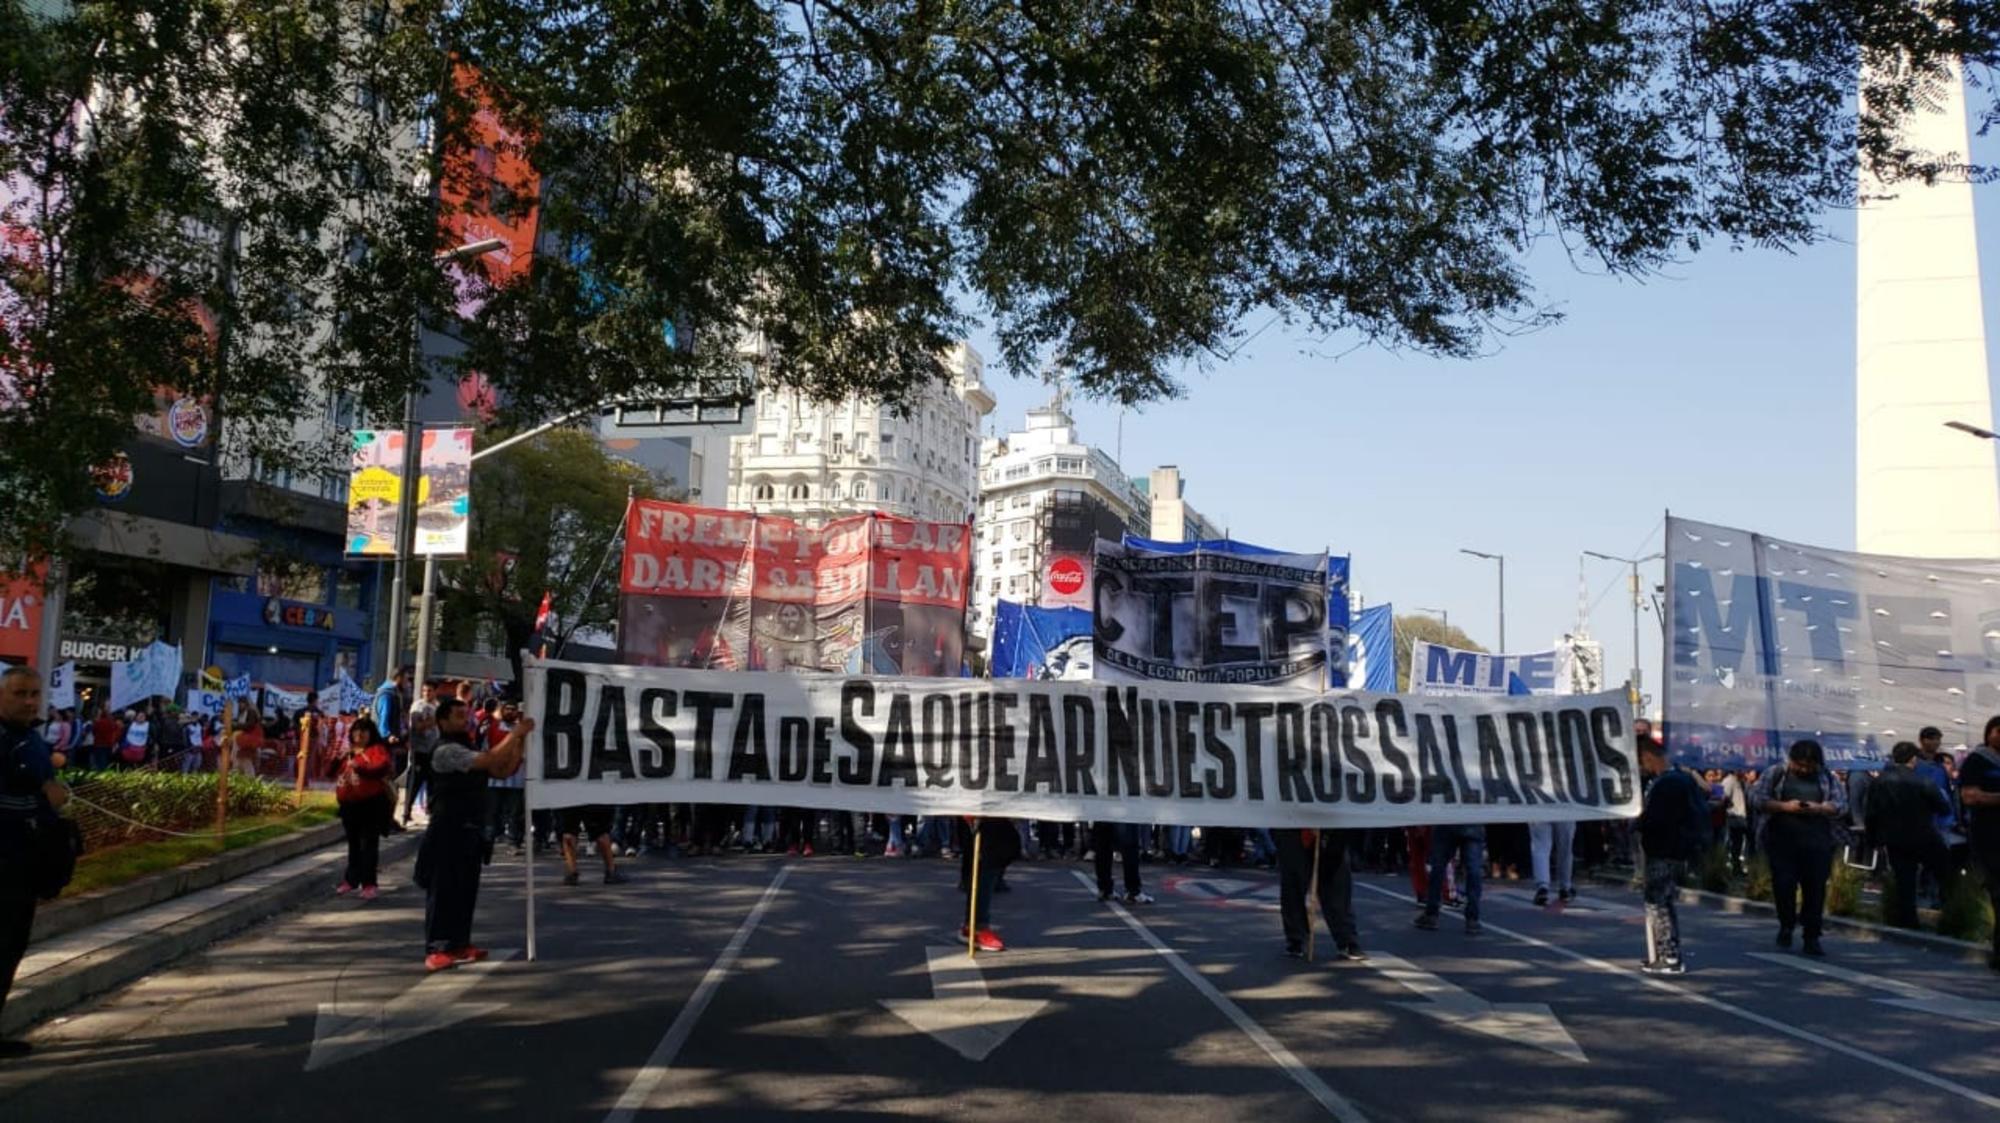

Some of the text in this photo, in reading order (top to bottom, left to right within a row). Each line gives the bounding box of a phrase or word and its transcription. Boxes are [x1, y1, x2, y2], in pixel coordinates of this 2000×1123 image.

[60, 640, 127, 661] BURGER
[1094, 568, 1324, 665] CTEP
[1673, 562, 1966, 690] MTE
[542, 668, 1634, 807] BASTA DE SAQUEAR NUESTROS SALARIOS
